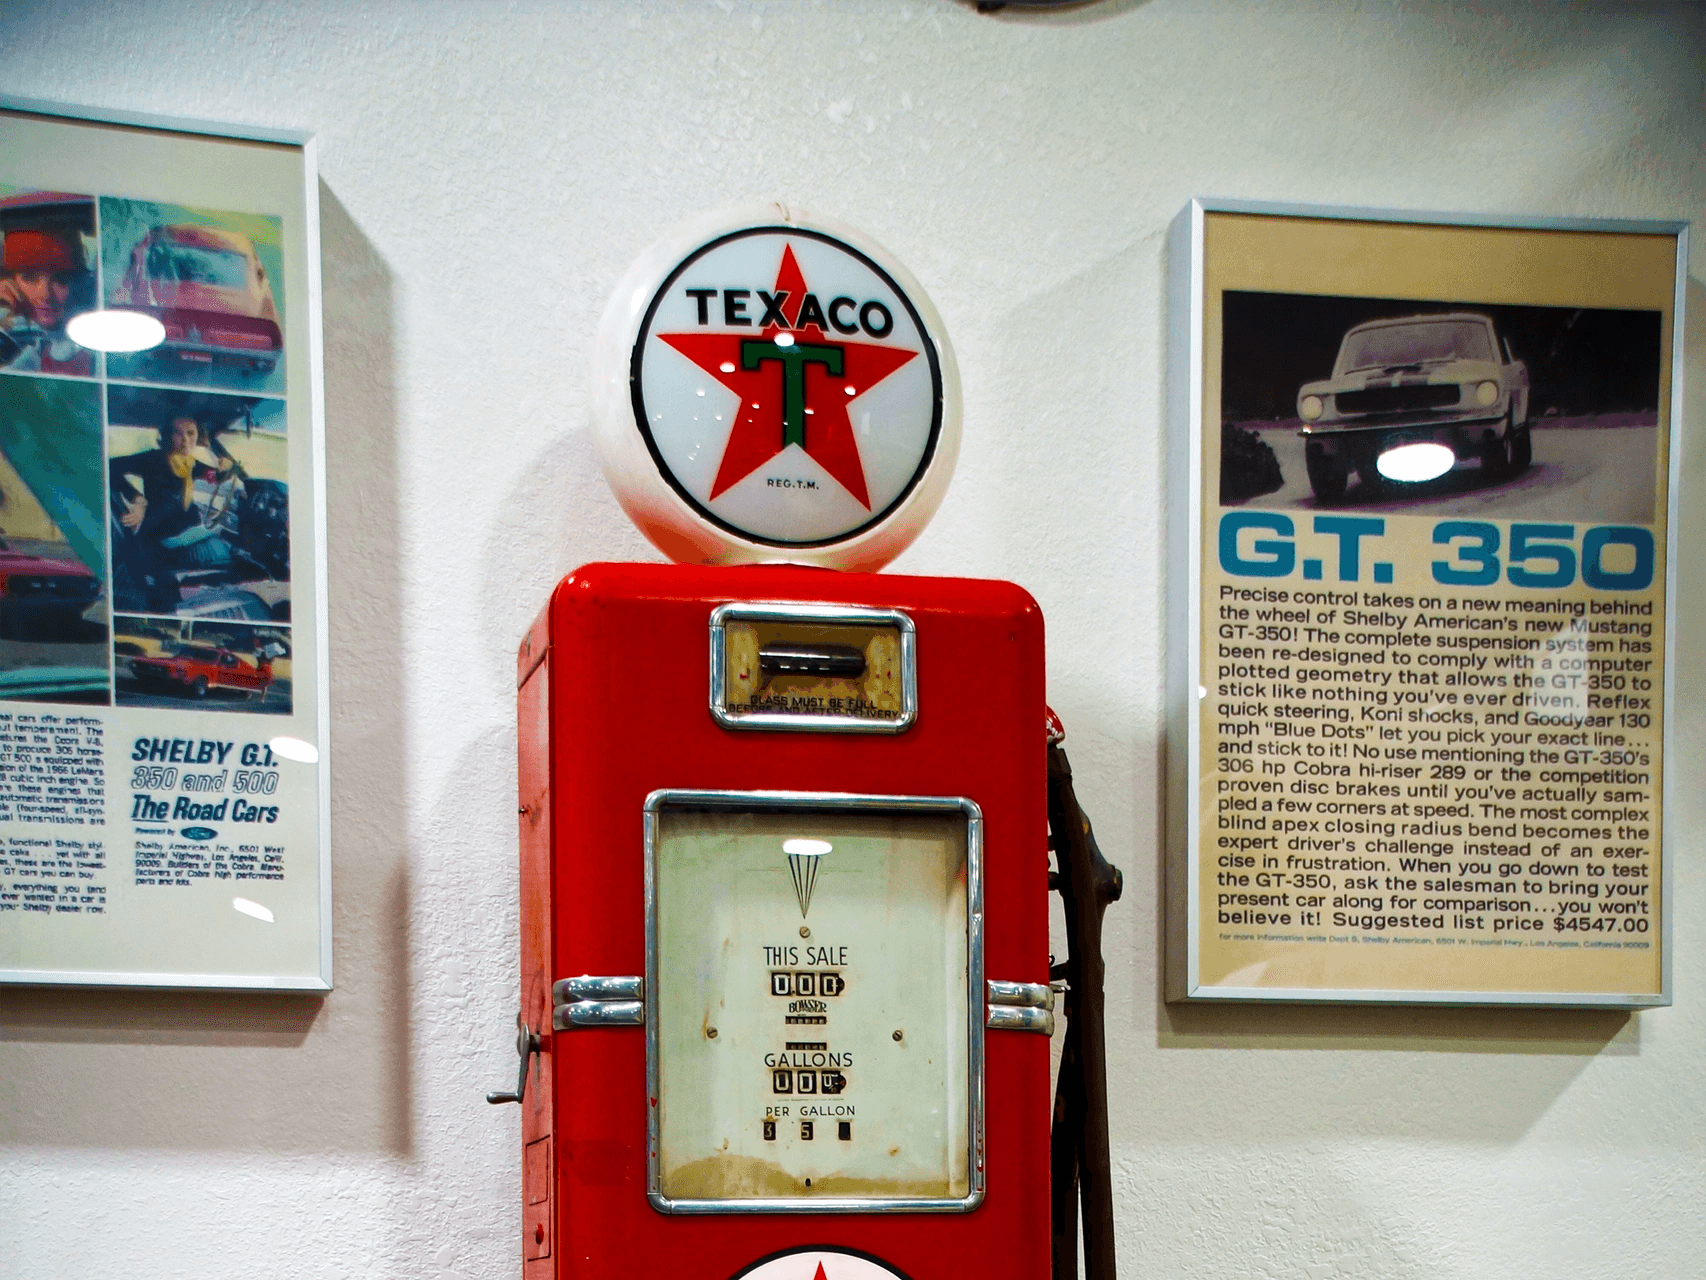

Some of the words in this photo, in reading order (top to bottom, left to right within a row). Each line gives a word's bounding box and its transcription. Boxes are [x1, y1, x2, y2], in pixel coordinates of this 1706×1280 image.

[685, 288, 894, 339] TEXACO
[740, 339, 846, 450] T
[1218, 511, 1394, 584] G.T.
[1431, 520, 1655, 591] 350
[1219, 585, 1290, 603] Precise
[1292, 590, 1358, 605] control
[1362, 591, 1415, 607] takes
[1417, 596, 1442, 608] on
[1445, 597, 1458, 609] a
[1461, 598, 1502, 611] new
[1504, 597, 1586, 617] meaning
[1589, 598, 1653, 616] behind
[1218, 604, 1250, 620] the
[1255, 606, 1311, 623] wheel
[1315, 608, 1337, 624] of
[1342, 608, 1408, 630] Shelby
[1413, 611, 1519, 630] American's
[1524, 619, 1565, 632] new
[1569, 617, 1653, 639] Mustang
[1218, 623, 1299, 641] GT-350!
[1302, 626, 1341, 643] The
[1343, 629, 1432, 648] complete
[1435, 634, 1541, 651] suspension
[1545, 638, 1614, 655] system
[1618, 637, 1653, 654] has
[751, 695, 788, 706] GLASS
[792, 697, 824, 708] MUST
[829, 698, 844, 708] BE
[849, 699, 877, 710] FULL
[1217, 701, 1269, 719] quick
[1273, 703, 1355, 723] steering,
[1360, 704, 1403, 721] Koni
[1407, 706, 1479, 726] shocks,
[1483, 709, 1520, 725] and
[1523, 710, 1615, 730] Goodyear
[1618, 712, 1651, 729] 130
[1217, 720, 1260, 739] mph
[1378, 724, 1403, 740] let
[1407, 729, 1442, 744] you
[1446, 726, 1486, 746] pick
[1489, 731, 1533, 747] your
[1536, 732, 1589, 746] exact
[131, 738, 234, 765] SHELBY
[1217, 739, 1253, 755] and
[1256, 740, 1302, 756] stick
[1305, 742, 1326, 757] to
[1329, 741, 1348, 757] it!
[1352, 742, 1381, 758] No
[1383, 747, 1418, 759] use
[1420, 745, 1525, 766] mentioning
[1528, 747, 1560, 763] the
[1563, 748, 1650, 766] GT-350's
[131, 766, 178, 790] 350
[181, 769, 229, 792] and
[232, 770, 280, 795] 500
[1217, 756, 1254, 773] 306
[1261, 758, 1286, 778] hp
[1293, 759, 1351, 776] Cobra
[1358, 761, 1423, 778] hi-riser
[1429, 763, 1467, 779] 289
[1472, 768, 1494, 780] or
[1499, 765, 1532, 781] the
[1538, 768, 1650, 786] competition
[1217, 780, 1284, 795] proven
[1289, 778, 1330, 794] disc
[1335, 779, 1401, 796] brakes
[1406, 782, 1449, 798] until
[1453, 783, 1517, 802] you've
[1521, 786, 1598, 806] actually
[1602, 791, 1650, 803] sam-
[131, 794, 170, 820] The
[173, 796, 230, 821] Road
[232, 799, 280, 823] Cars
[1217, 795, 1258, 815] pled
[1260, 800, 1273, 812] a
[1275, 797, 1313, 813] few
[1315, 802, 1387, 815] corners
[1389, 801, 1410, 816] at
[1413, 801, 1475, 820] speed.
[1478, 802, 1516, 818] The
[1519, 805, 1568, 820] most
[1570, 805, 1650, 825] complex
[1217, 814, 1267, 830] blind
[1271, 819, 1320, 835] apex
[1323, 817, 1396, 838] closing
[1400, 819, 1463, 836] radius
[1467, 820, 1517, 837] bend
[1522, 822, 1613, 840] becomes
[1616, 825, 1650, 841] the
[1216, 836, 1279, 853] expert
[1286, 835, 1356, 852] driver's
[1364, 837, 1454, 858] challenge
[1463, 839, 1532, 856] instead
[1540, 841, 1562, 857] of
[1569, 845, 1593, 857] an
[1601, 846, 1650, 859] exer-
[1217, 852, 1256, 868] cise
[1262, 853, 1279, 869] in
[1285, 853, 1391, 871] frustration.
[1398, 856, 1452, 873] When
[1457, 862, 1492, 877] you
[1497, 863, 1523, 878] go
[1527, 859, 1579, 876] down
[1585, 862, 1606, 877] to
[1611, 863, 1649, 878] test
[1216, 870, 1250, 886] the
[1254, 871, 1337, 891] GT-350,
[1343, 874, 1379, 890] ask
[1384, 875, 1418, 891] the
[1422, 876, 1517, 893] salesman
[1521, 879, 1544, 894] to
[1548, 879, 1599, 899] bring
[1604, 884, 1650, 900] your
[1217, 892, 1290, 909] present
[1295, 895, 1327, 908] car
[1331, 892, 1384, 913] along
[1388, 893, 1418, 910] for
[1597, 899, 1649, 915] won't
[1217, 908, 1292, 925] believe
[1300, 910, 1321, 926] it!
[1332, 911, 1445, 931] Suggested
[1452, 913, 1485, 929] list
[1492, 914, 1545, 933] price
[1552, 915, 1649, 933] $4547.00
[763, 947, 798, 966] THIS
[806, 947, 848, 966] SALE
[789, 999, 828, 1013] BOWSER
[764, 1053, 853, 1067] GALLONS
[766, 1106, 790, 1117] PER
[800, 1105, 855, 1117] GALLON
